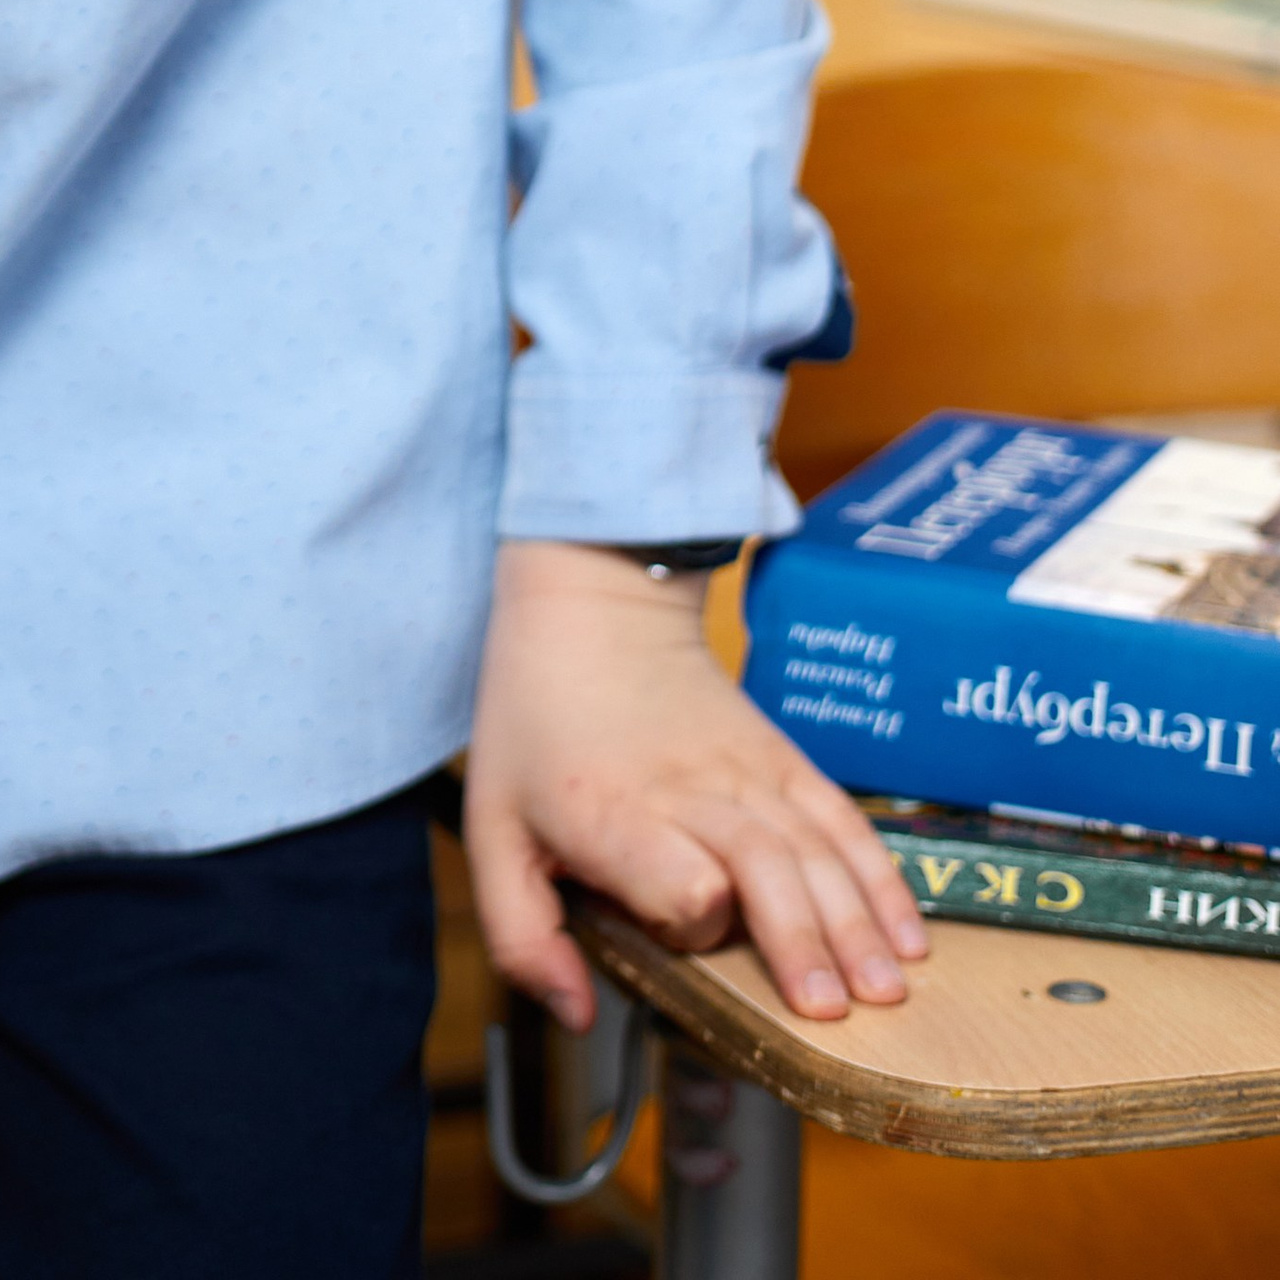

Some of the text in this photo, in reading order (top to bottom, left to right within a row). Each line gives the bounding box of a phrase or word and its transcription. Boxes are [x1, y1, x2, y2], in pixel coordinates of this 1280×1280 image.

[781, 692, 906, 739] История
[942, 665, 1255, 777] Петербург
[889, 851, 1085, 913] СКА
